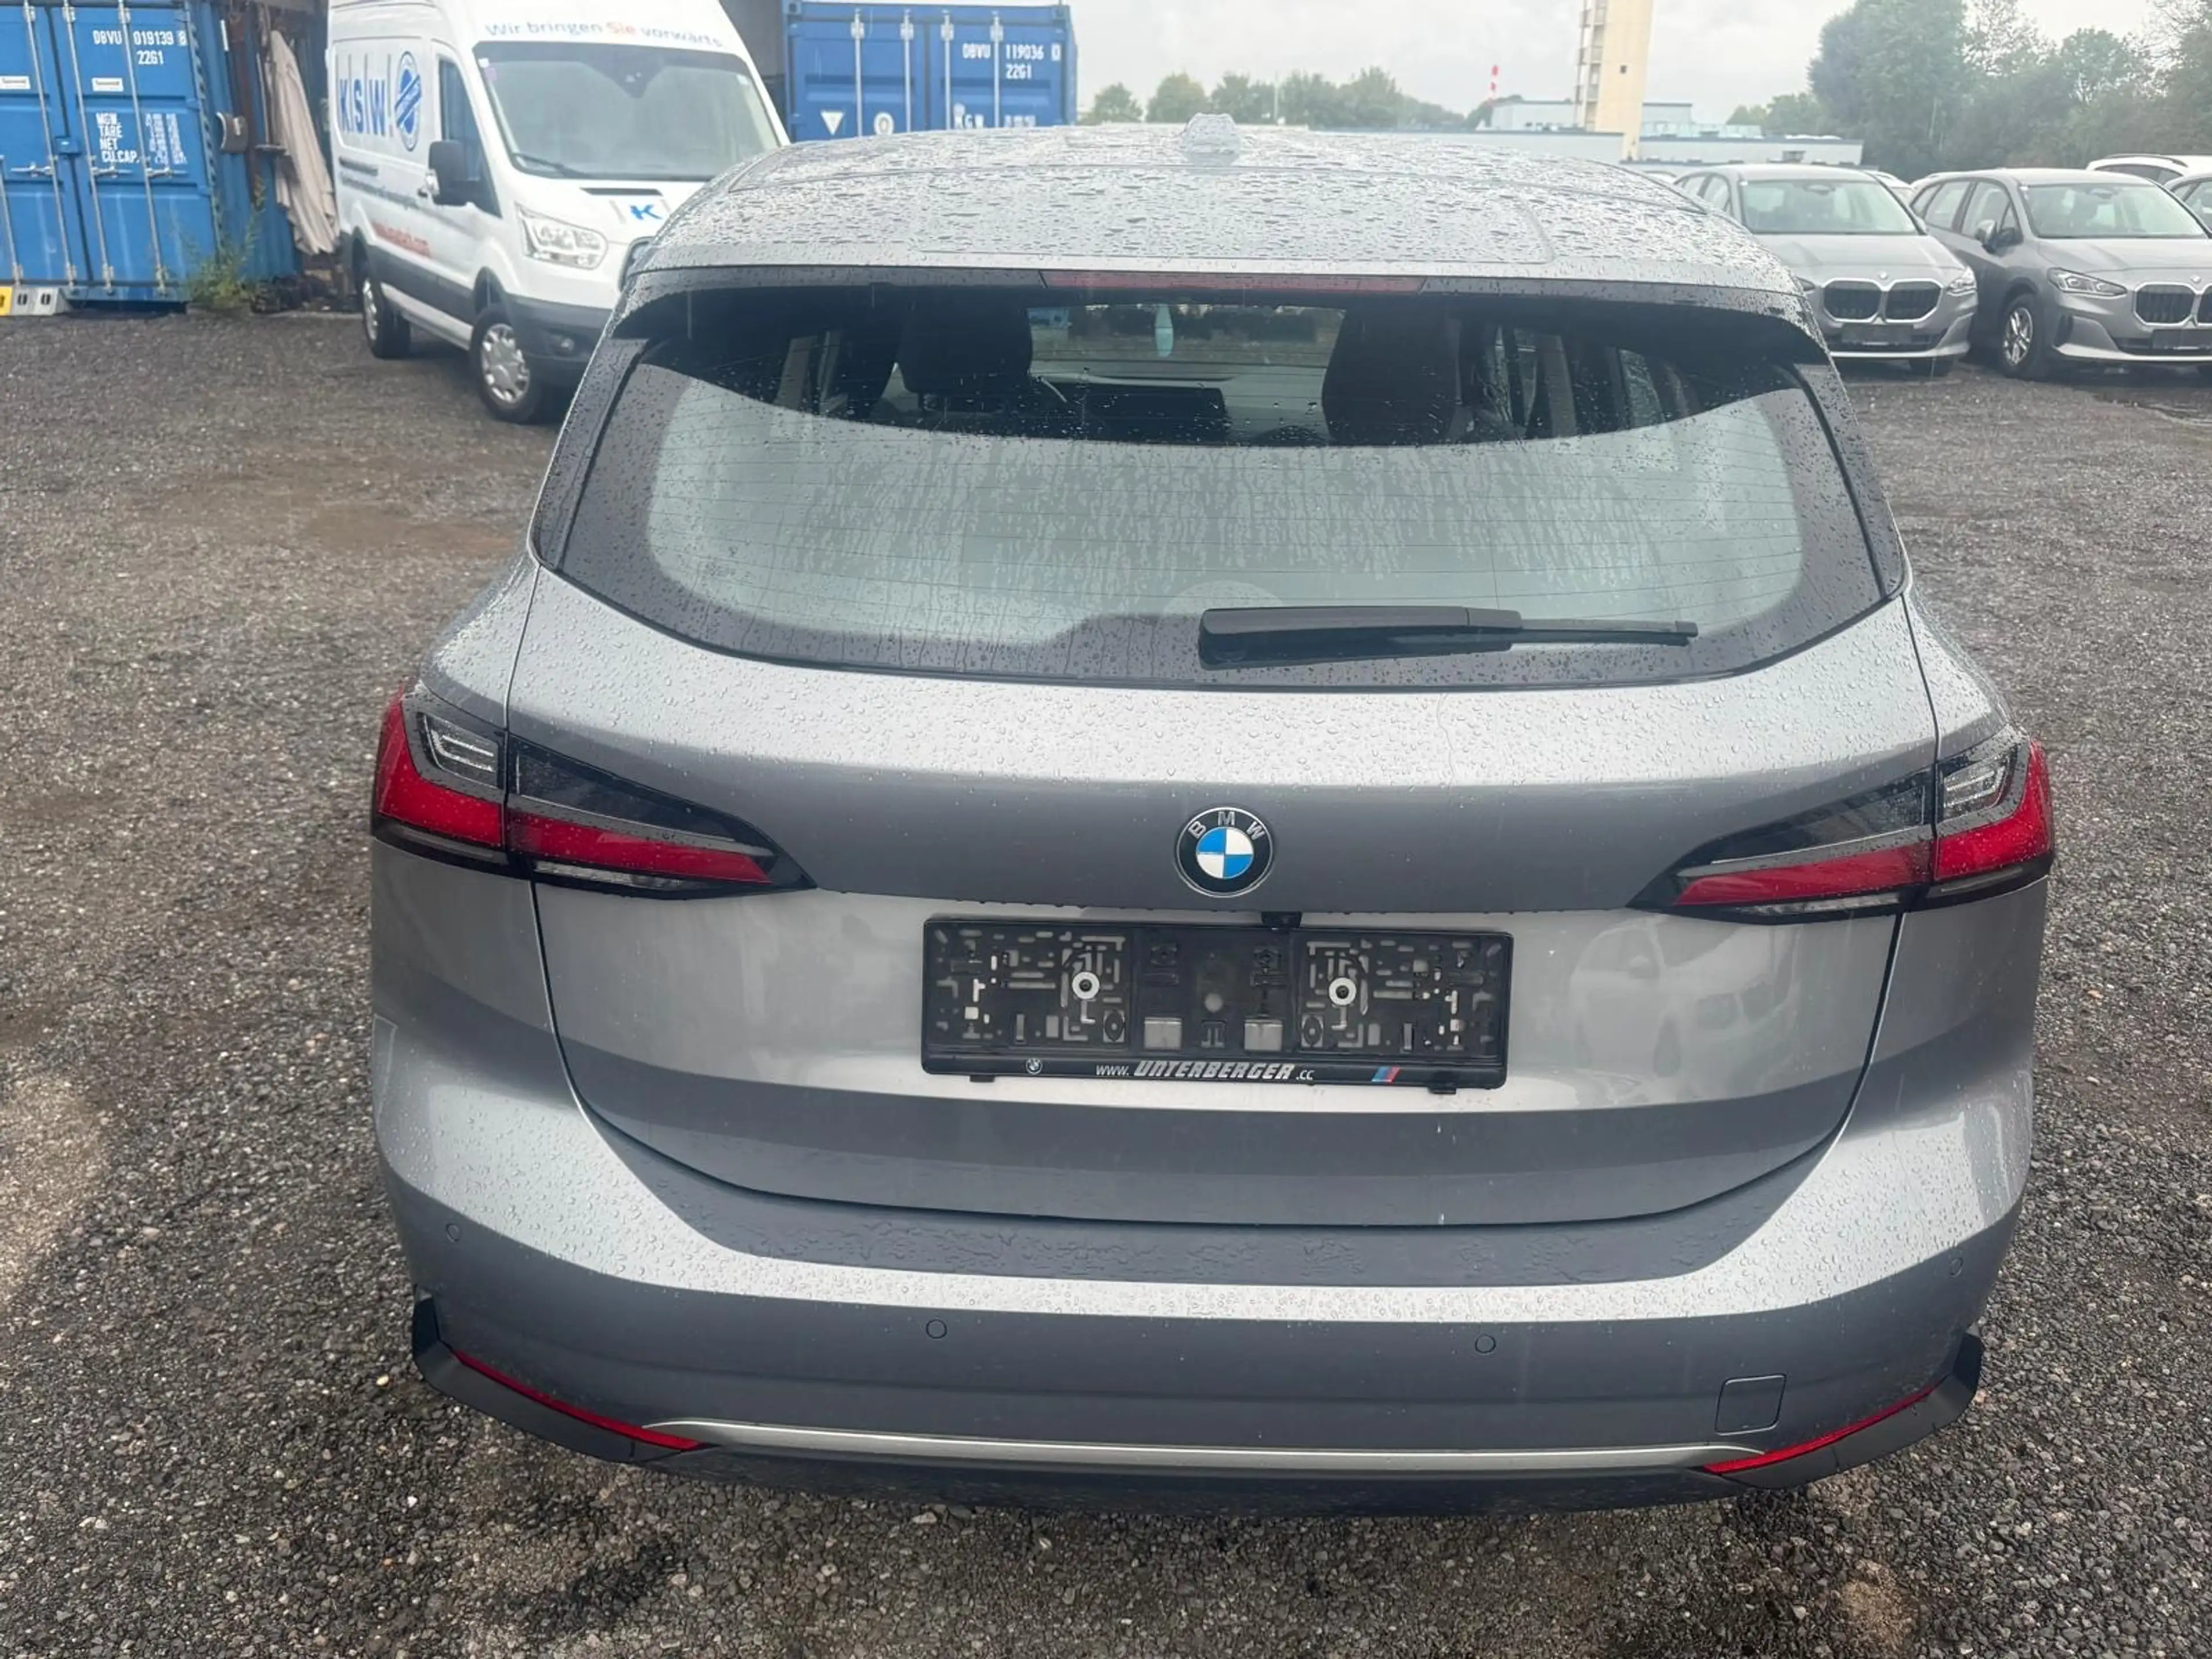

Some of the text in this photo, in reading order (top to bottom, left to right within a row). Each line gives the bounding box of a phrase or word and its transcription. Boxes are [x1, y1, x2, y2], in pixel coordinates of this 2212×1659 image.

[484, 23, 520, 36] Wir
[527, 21, 603, 35] bringen
[605, 22, 636, 35] Sie
[1188, 811, 1265, 840] BMW
[1096, 1065, 1128, 1075] www.
[1134, 1060, 1295, 1080] UNTERBERGER
